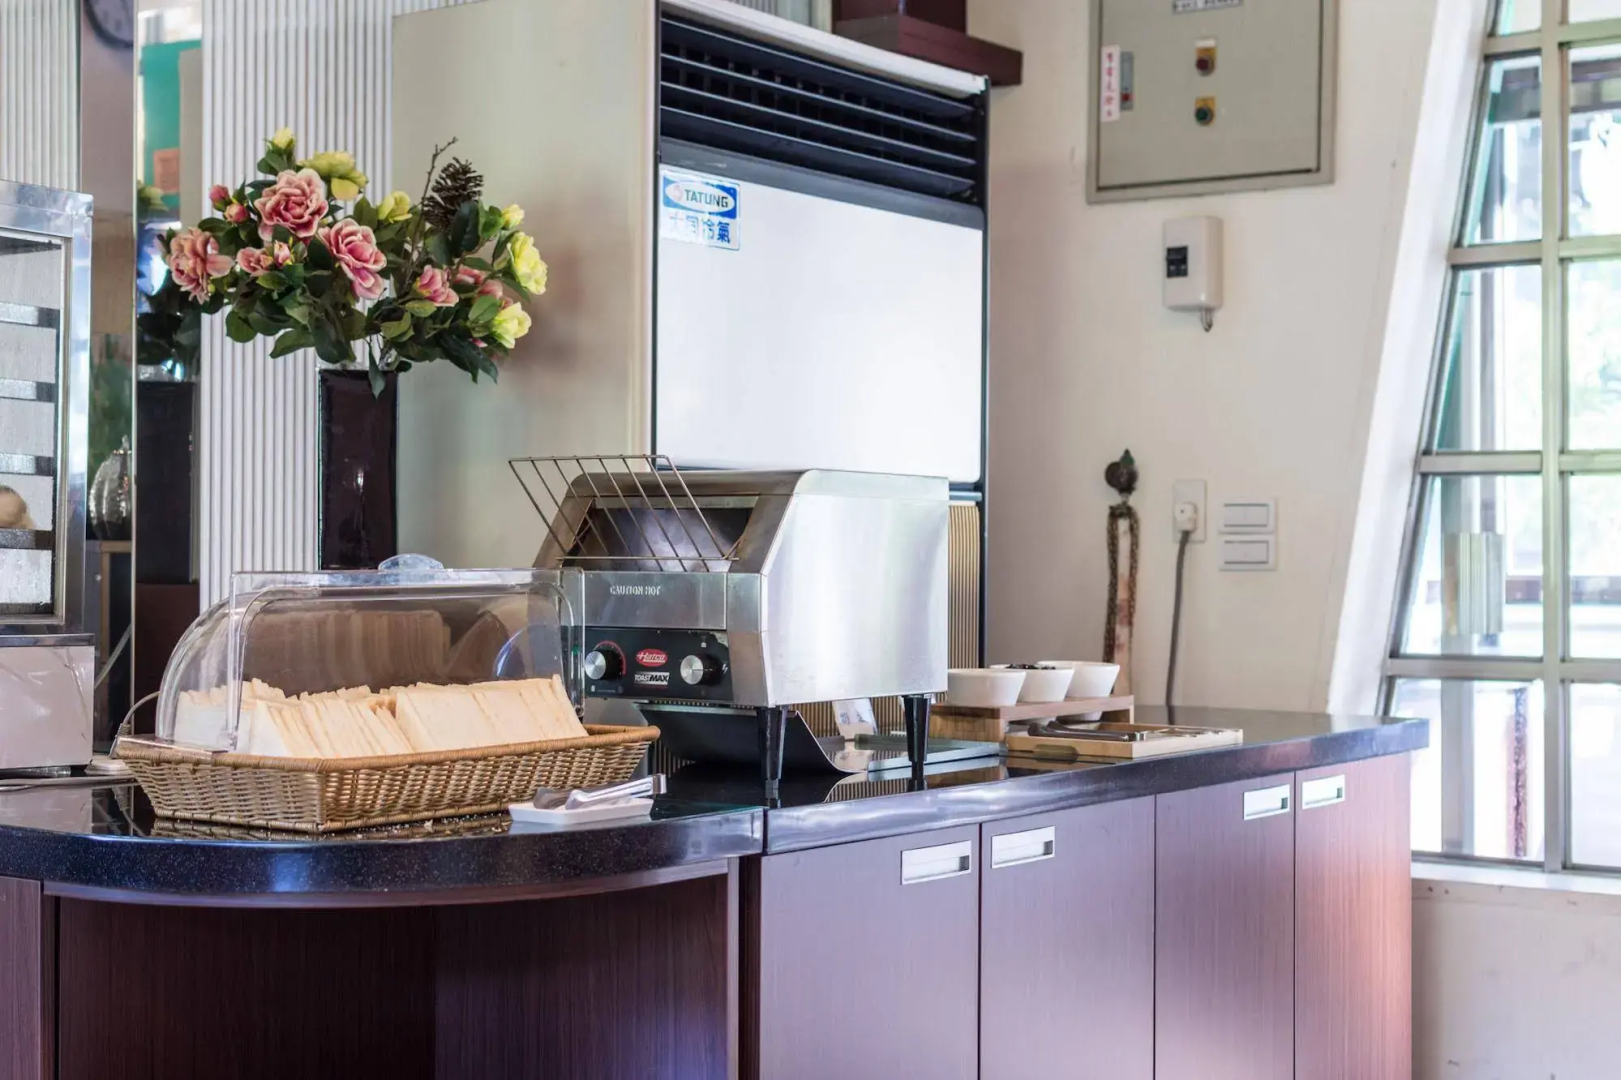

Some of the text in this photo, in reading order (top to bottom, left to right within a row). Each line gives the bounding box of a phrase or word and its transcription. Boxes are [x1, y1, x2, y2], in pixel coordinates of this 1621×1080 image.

[684, 189, 729, 208] TATUNG
[610, 584, 661, 596] CAUTION HOT
[636, 652, 666, 661] Hatco
